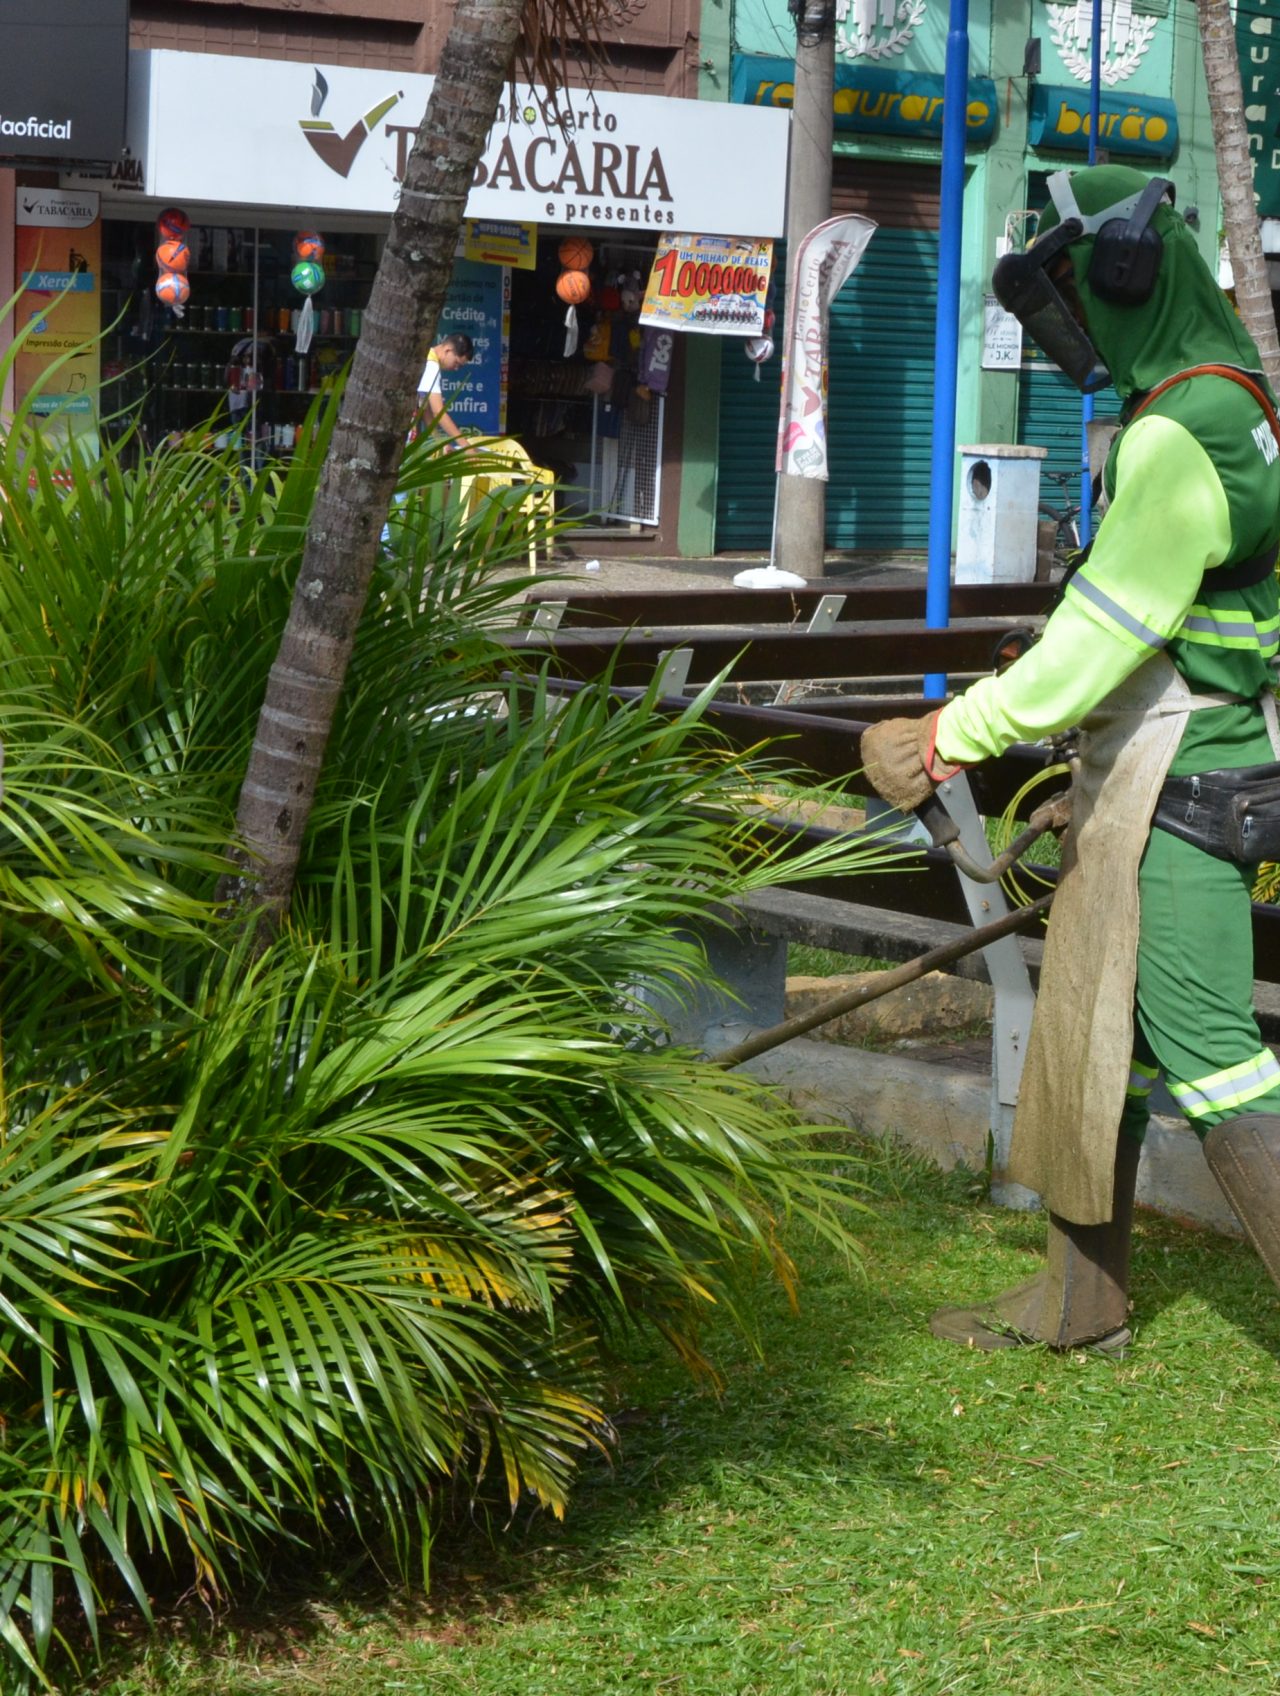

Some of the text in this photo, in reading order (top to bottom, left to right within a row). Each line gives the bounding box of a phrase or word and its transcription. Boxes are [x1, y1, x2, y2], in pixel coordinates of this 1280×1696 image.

[37, 204, 93, 217] TABACARIA
[545, 202, 675, 225] e presentes
[679, 251, 693, 261] UM
[441, 306, 486, 321] Crédito
[25, 338, 62, 350] Impressão
[441, 379, 484, 392] Entre e
[443, 398, 488, 413] onfira
